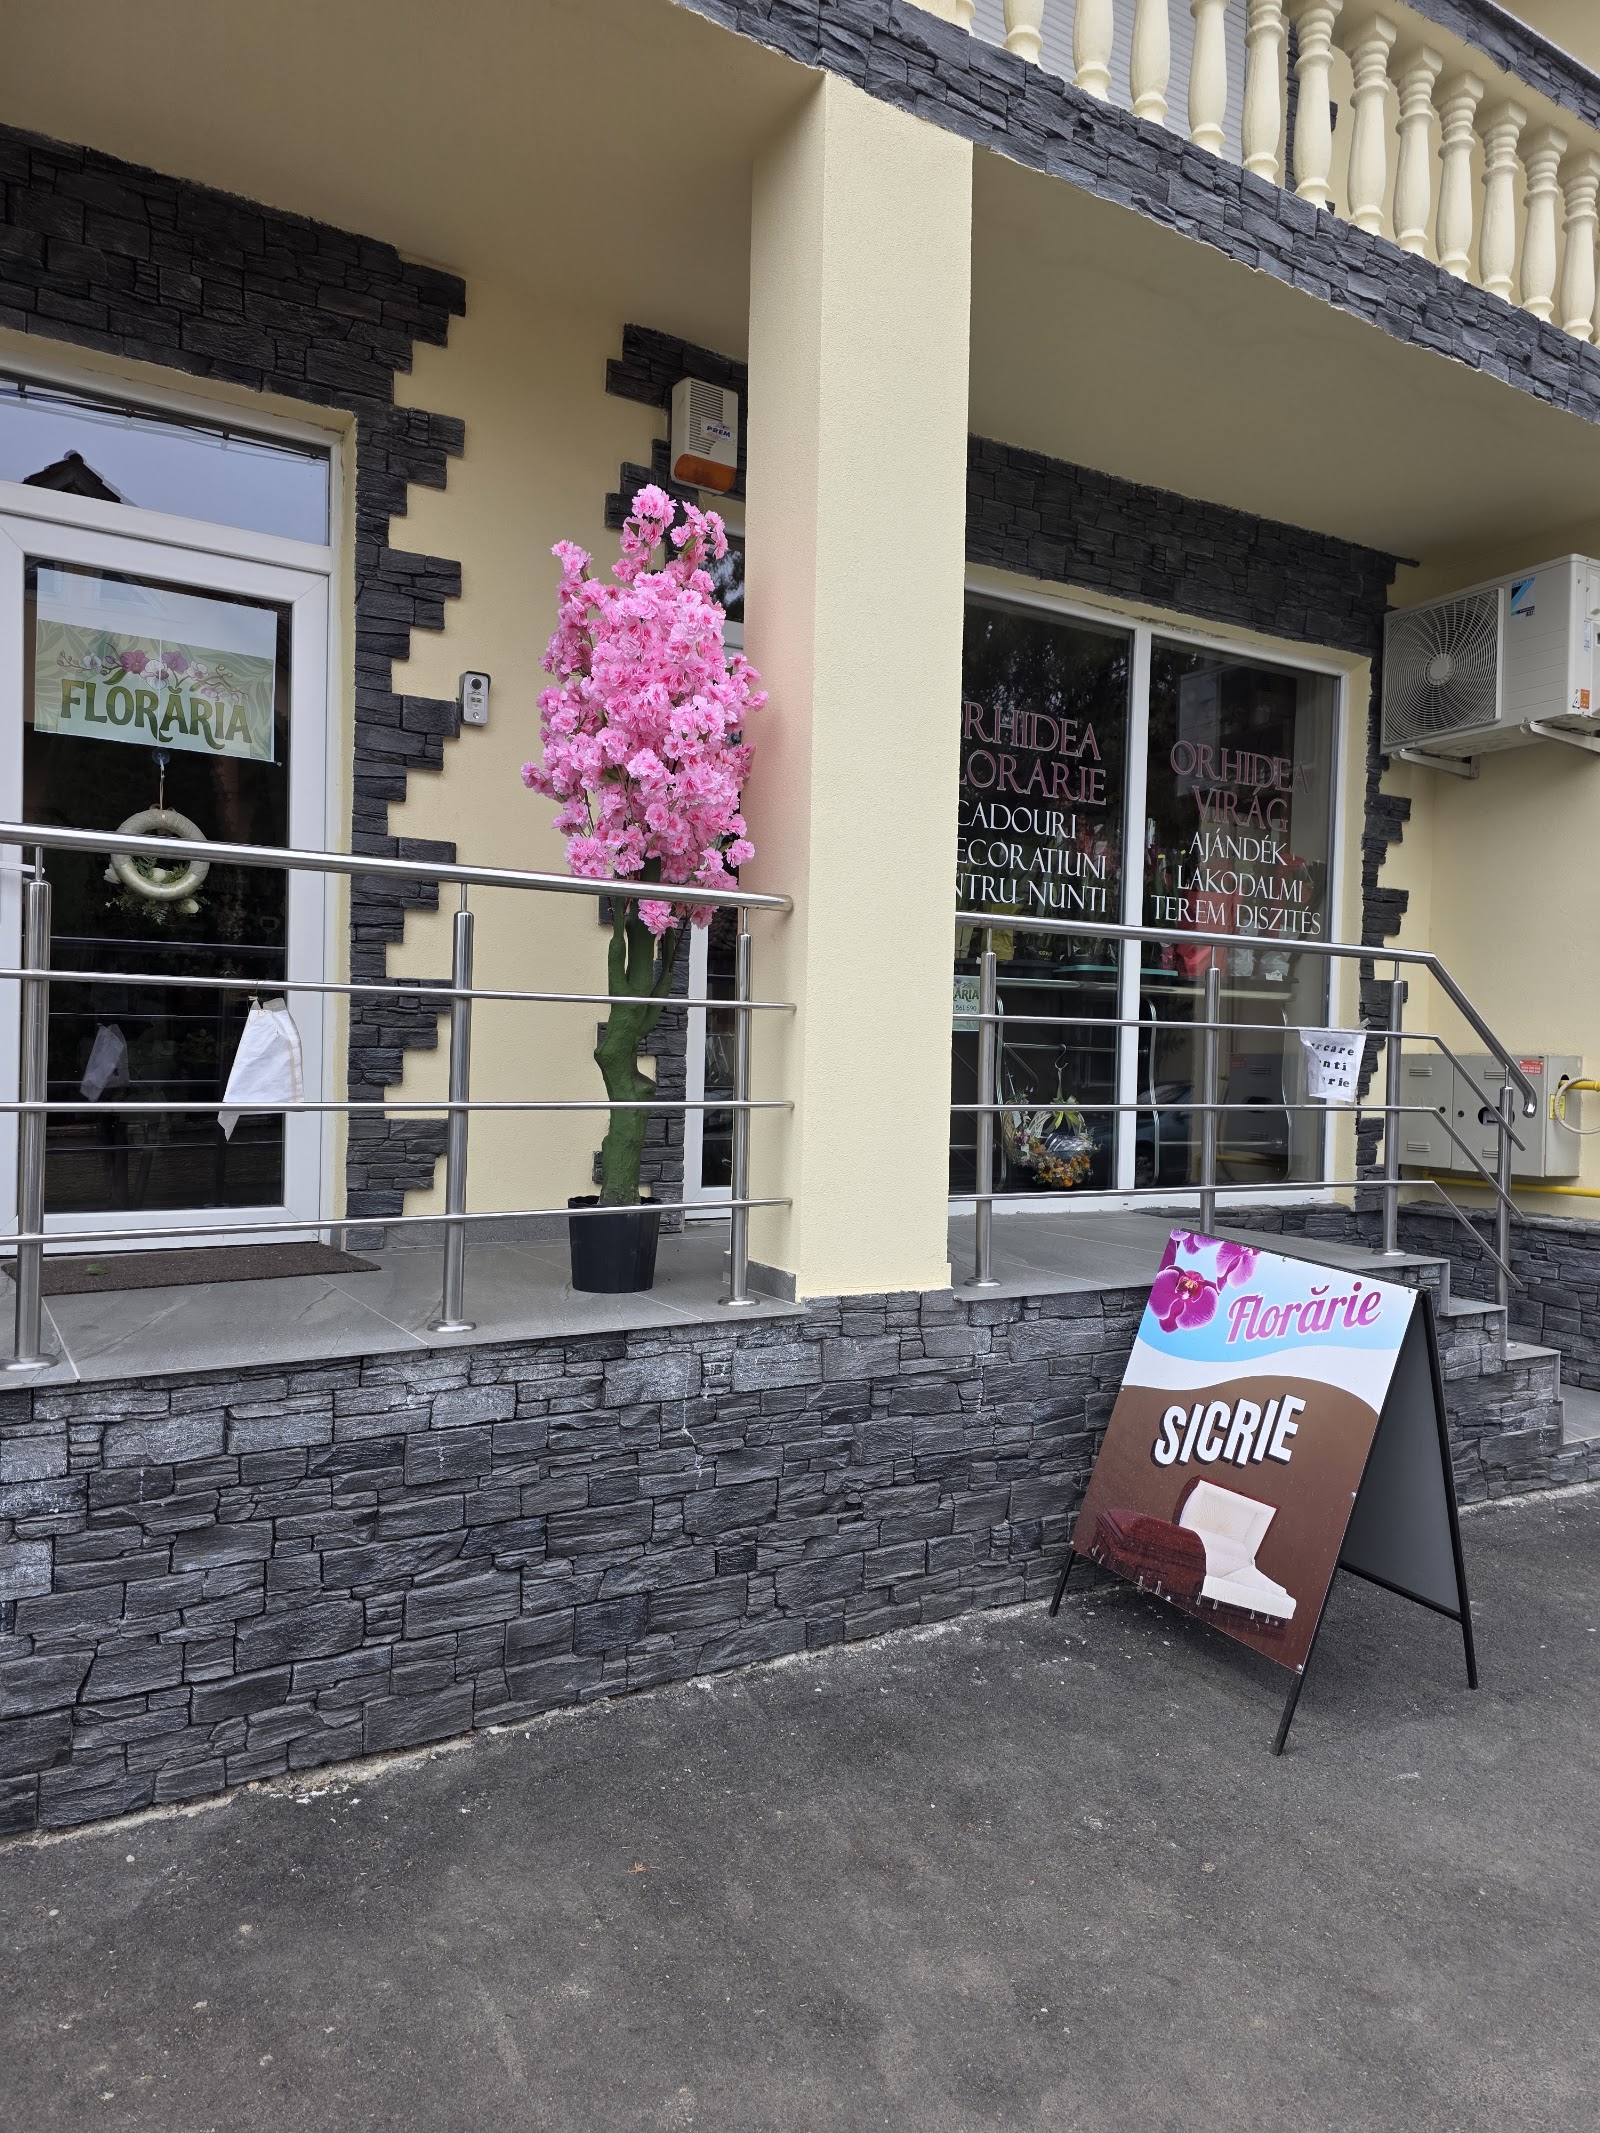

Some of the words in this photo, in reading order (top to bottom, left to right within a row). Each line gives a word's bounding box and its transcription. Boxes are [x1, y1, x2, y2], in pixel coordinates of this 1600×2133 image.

[60, 678, 253, 750] FLORĂRIA
[960, 700, 1102, 761] RHIDEA
[1169, 739, 1310, 794] ORHIDEA
[957, 799, 1077, 840] CADOURI
[1191, 784, 1289, 834] VIRÁG
[1188, 827, 1289, 866] AJÁNDÉK
[1028, 879, 1107, 913] NUNTI
[1176, 864, 1303, 904] LAKODALMI
[1150, 894, 1227, 926] TEREM
[1235, 905, 1322, 936] DISZITÉS
[1318, 1059, 1347, 1071] nti
[1322, 1076, 1350, 1087] rie
[1227, 1281, 1383, 1343] Florărie
[1150, 1393, 1307, 1469] SICRIE
